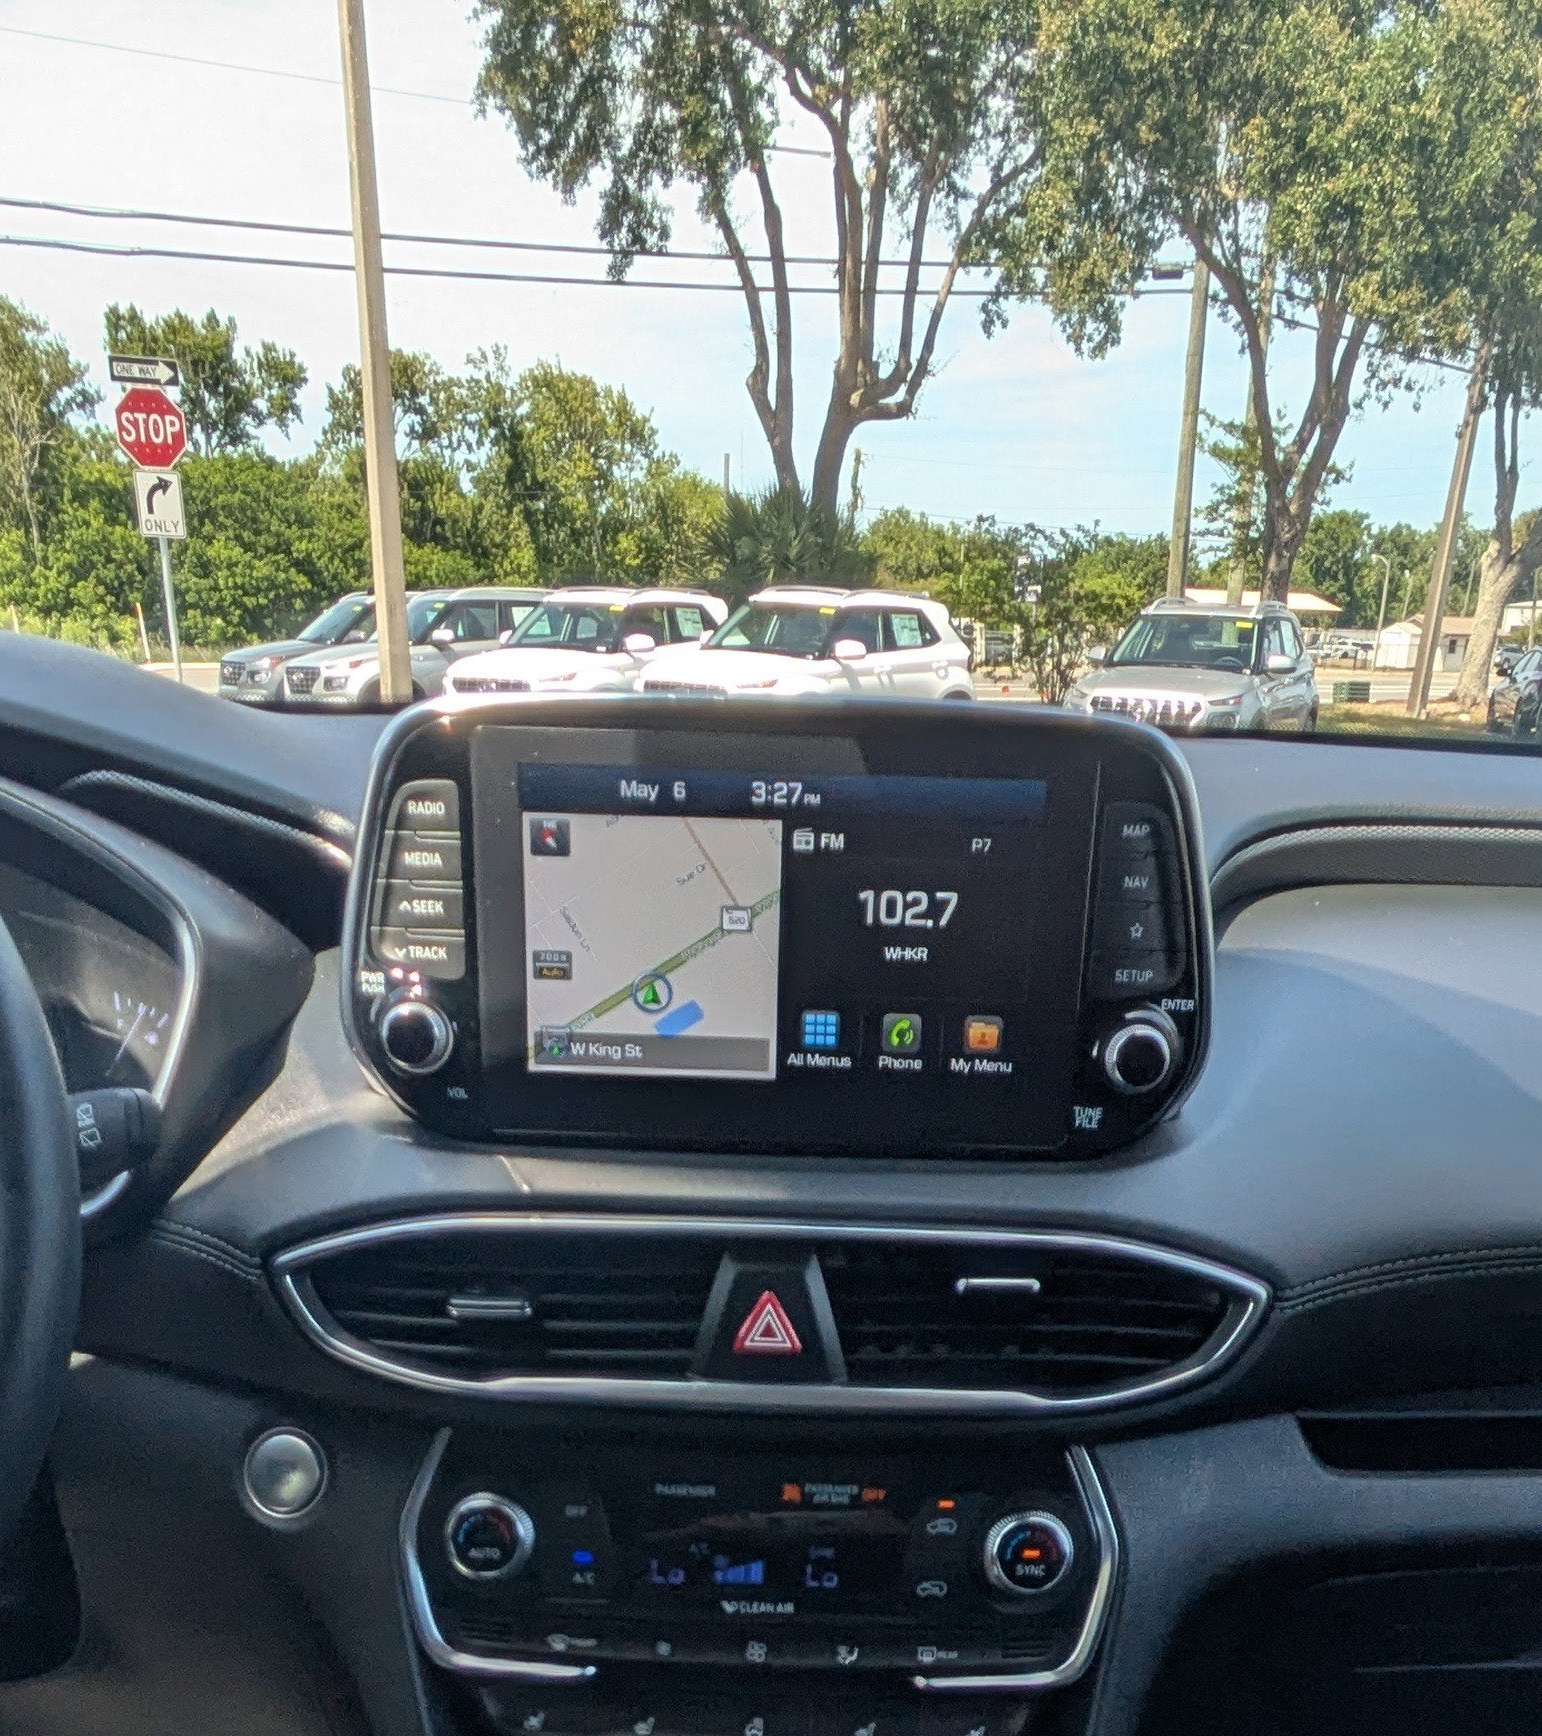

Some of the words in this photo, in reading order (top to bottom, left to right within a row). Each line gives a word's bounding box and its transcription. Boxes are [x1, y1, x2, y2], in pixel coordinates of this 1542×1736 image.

[115, 362, 136, 376] ONE
[138, 365, 158, 377] WAY
[120, 411, 180, 444] STOP
[144, 518, 180, 534] ONLY
[620, 779, 658, 801] May
[673, 782, 686, 801] 6
[751, 781, 802, 804] 3:27
[408, 801, 445, 816] RADIO
[1122, 824, 1150, 837] MAP
[820, 833, 844, 850] FM
[972, 838, 992, 852] P7
[404, 851, 442, 867] MEDIA
[1124, 876, 1149, 889] NAV
[412, 900, 444, 915] SEEK
[859, 889, 959, 928] 102.7
[408, 945, 447, 960] TRACK
[884, 946, 929, 962] WHKR
[361, 971, 385, 982] PWR
[1115, 968, 1154, 983] SETUP
[362, 982, 385, 993] PUSH
[1161, 998, 1195, 1011] ENTER
[570, 1043, 586, 1056] W
[589, 1043, 622, 1059] King
[625, 1043, 642, 1057] St
[787, 1053, 806, 1067] All
[807, 1054, 851, 1068] Menus
[878, 1056, 922, 1070] Phone
[951, 1058, 972, 1074] My
[974, 1059, 1013, 1073] Menu
[447, 1086, 468, 1099] VOL
[1073, 1105, 1103, 1118] TUNE
[1075, 1116, 1100, 1129] FILE
[1015, 1565, 1046, 1577] SYNC
[739, 1601, 775, 1613] CLEAN
[776, 1601, 795, 1614] AIR
